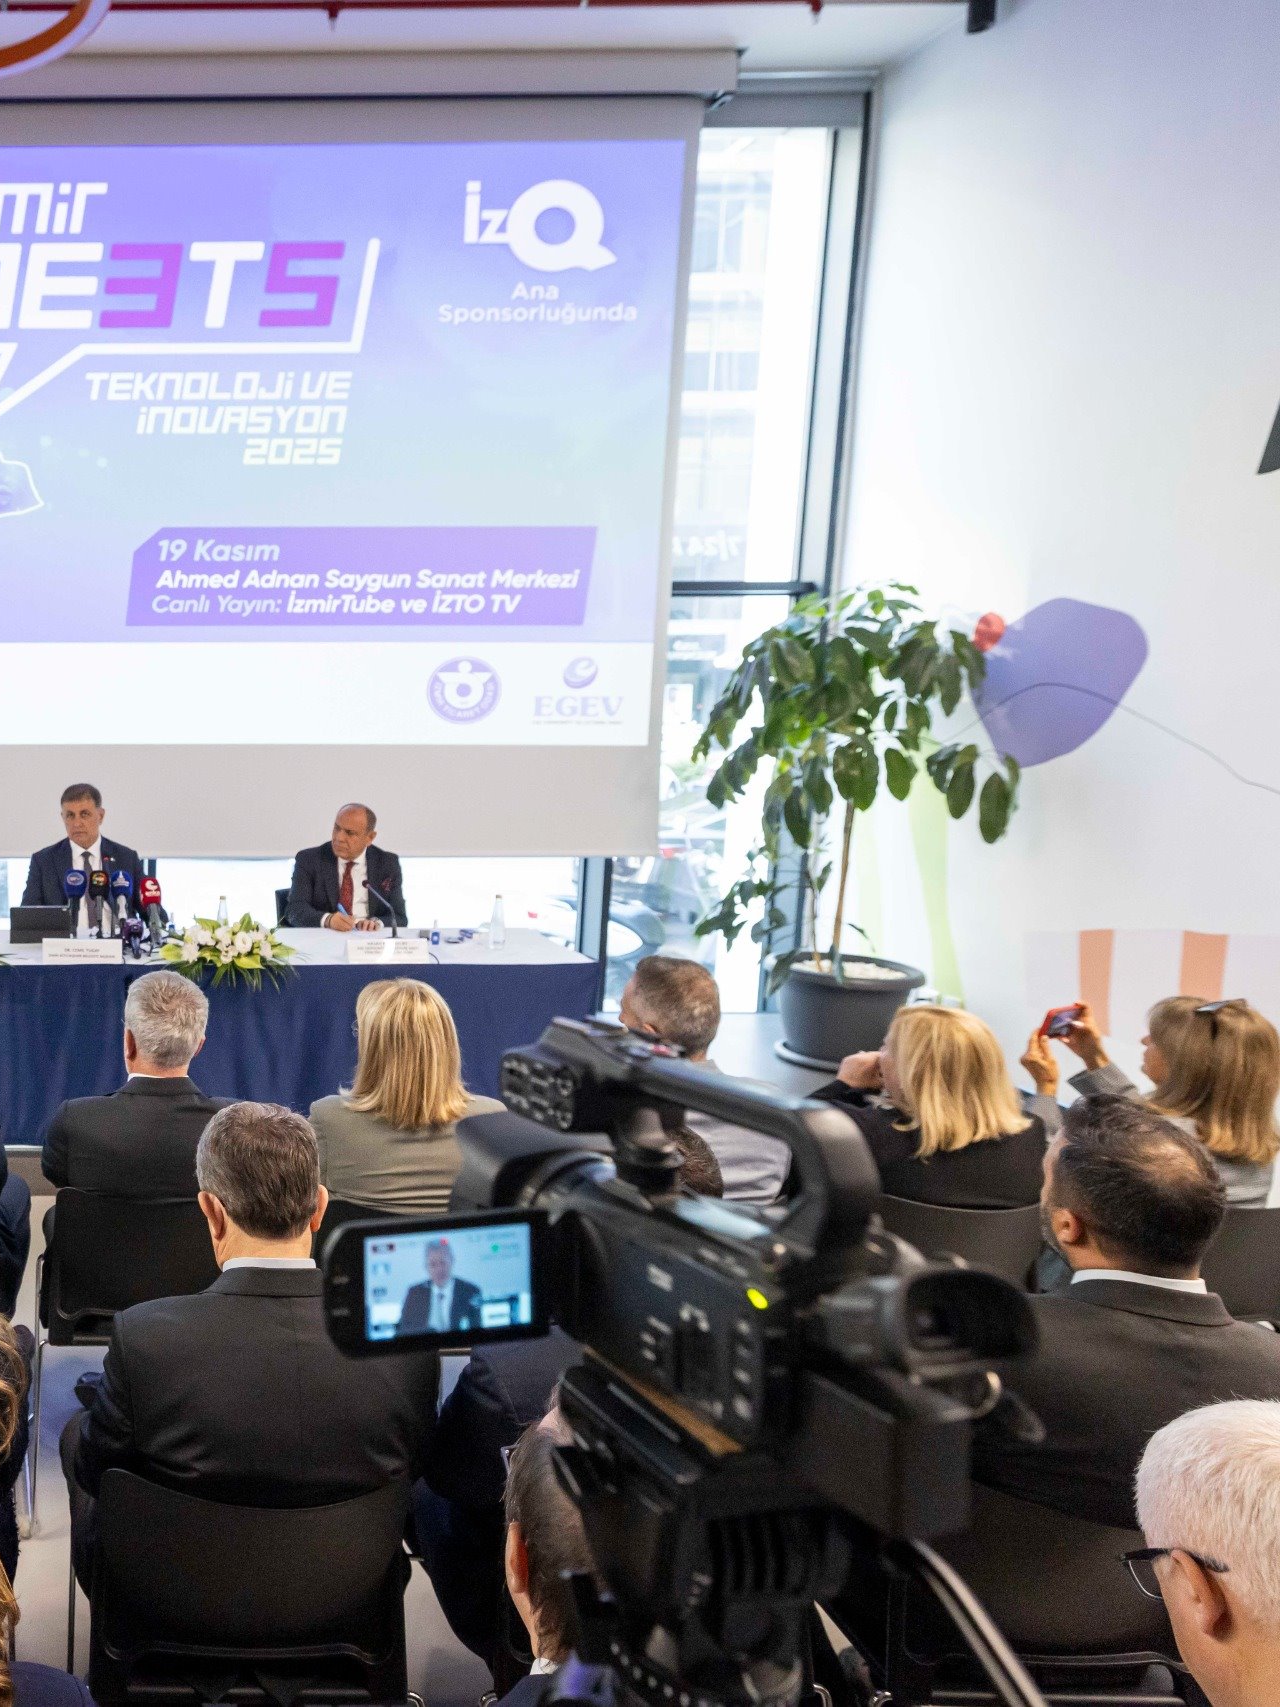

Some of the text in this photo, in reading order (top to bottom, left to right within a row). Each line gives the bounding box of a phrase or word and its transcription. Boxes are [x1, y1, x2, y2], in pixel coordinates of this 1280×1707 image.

[511, 282, 559, 300] Ana
[438, 302, 637, 326] Sponsorluğunda
[299, 371, 353, 400] VE
[242, 438, 344, 465] 2025
[158, 539, 280, 562] 19 Kasım
[155, 569, 581, 593] Ahmed Adnan Saygun Sanat Merkezi
[151, 594, 211, 614] Canlı
[217, 594, 282, 617] Yayın:
[400, 599, 428, 614] ve
[431, 590, 486, 614] İZTO
[489, 594, 522, 614] TV
[532, 696, 625, 717] EGEV
